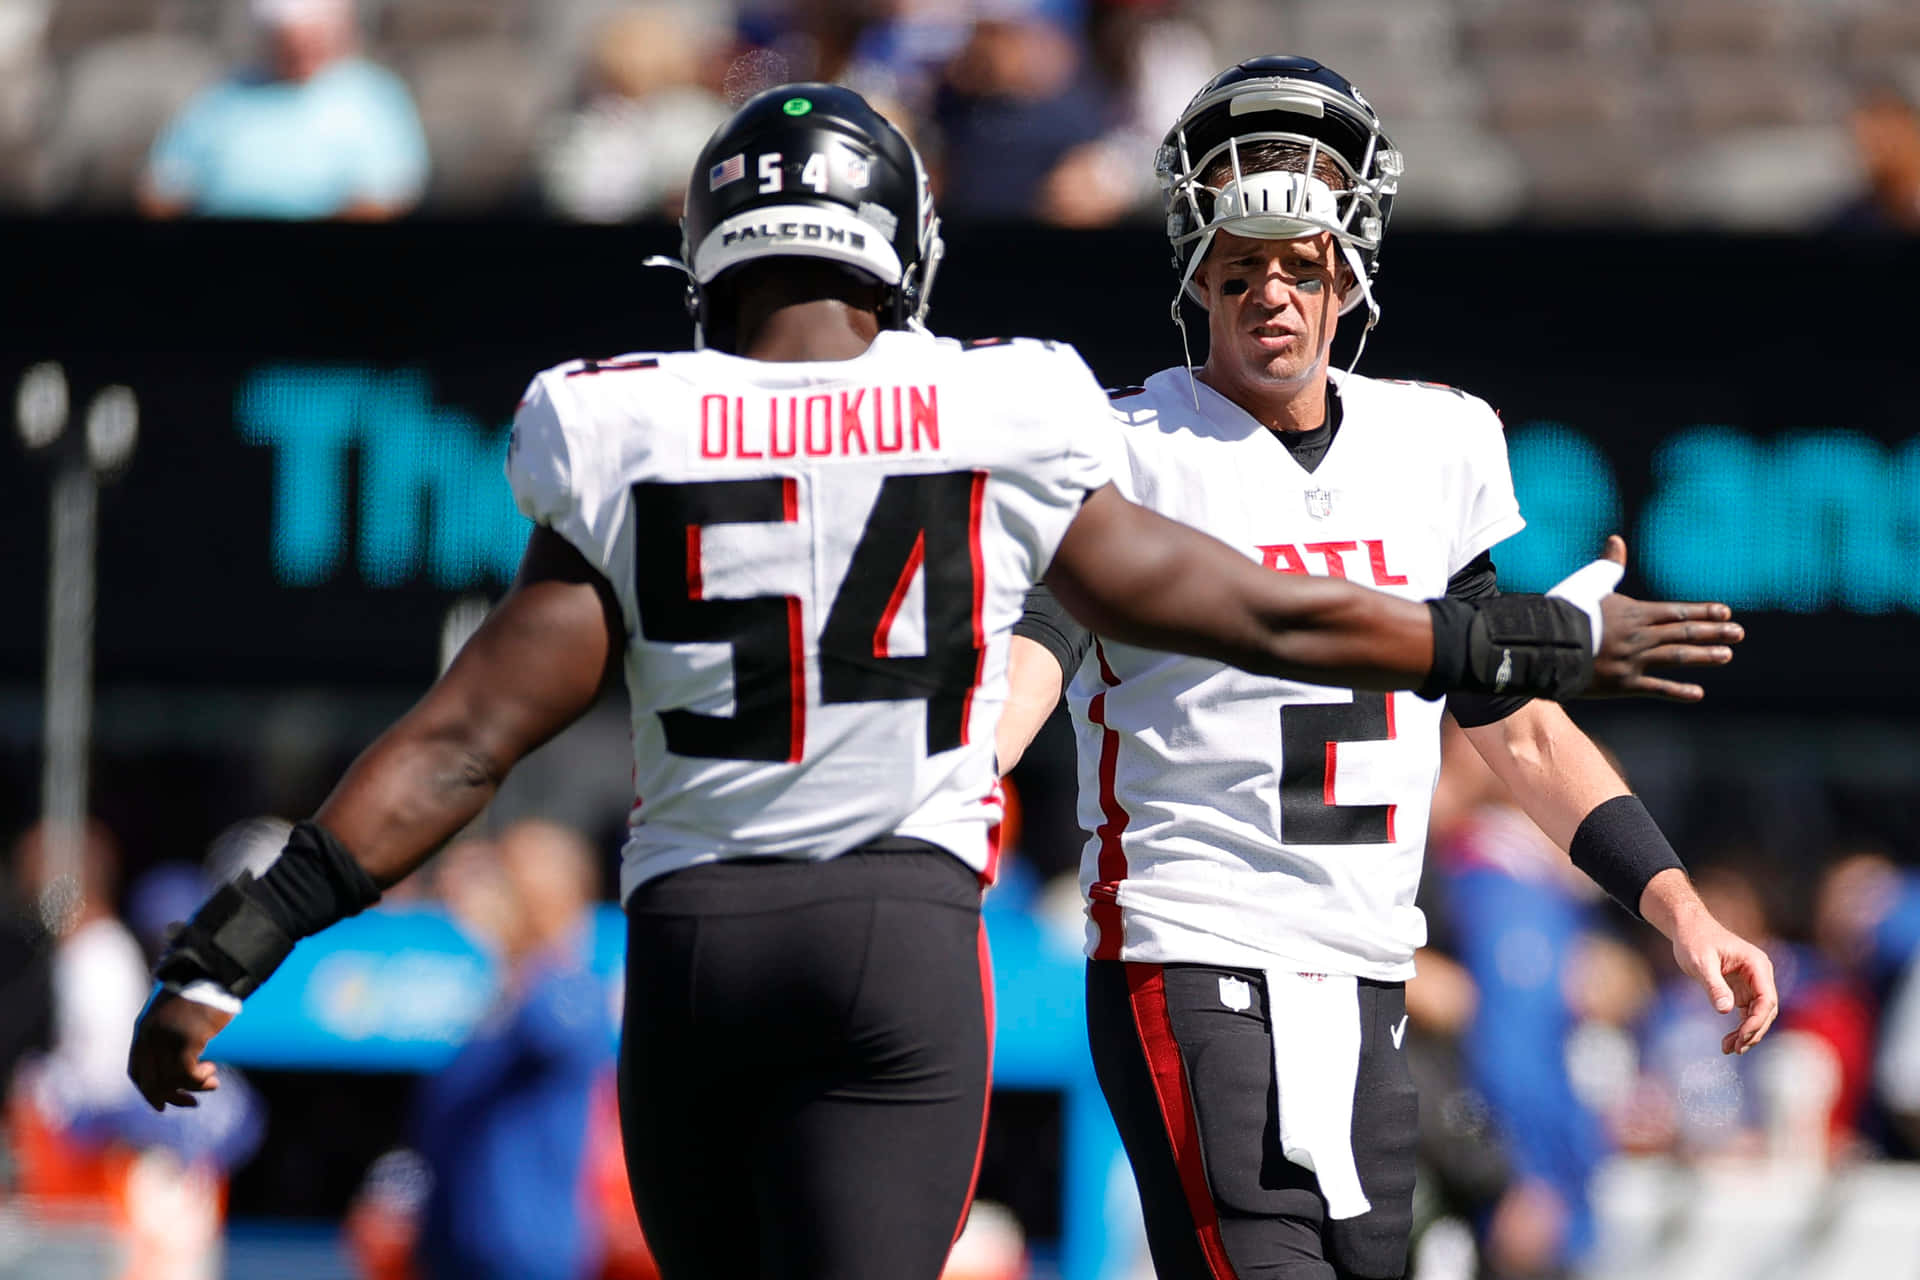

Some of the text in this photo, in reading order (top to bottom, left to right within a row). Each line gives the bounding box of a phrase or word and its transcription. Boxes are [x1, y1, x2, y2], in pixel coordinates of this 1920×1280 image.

[721, 222, 866, 250] FALCONS
[700, 385, 942, 460] OLUOKUN
[1254, 539, 1409, 587] ATL
[631, 469, 988, 764] 54
